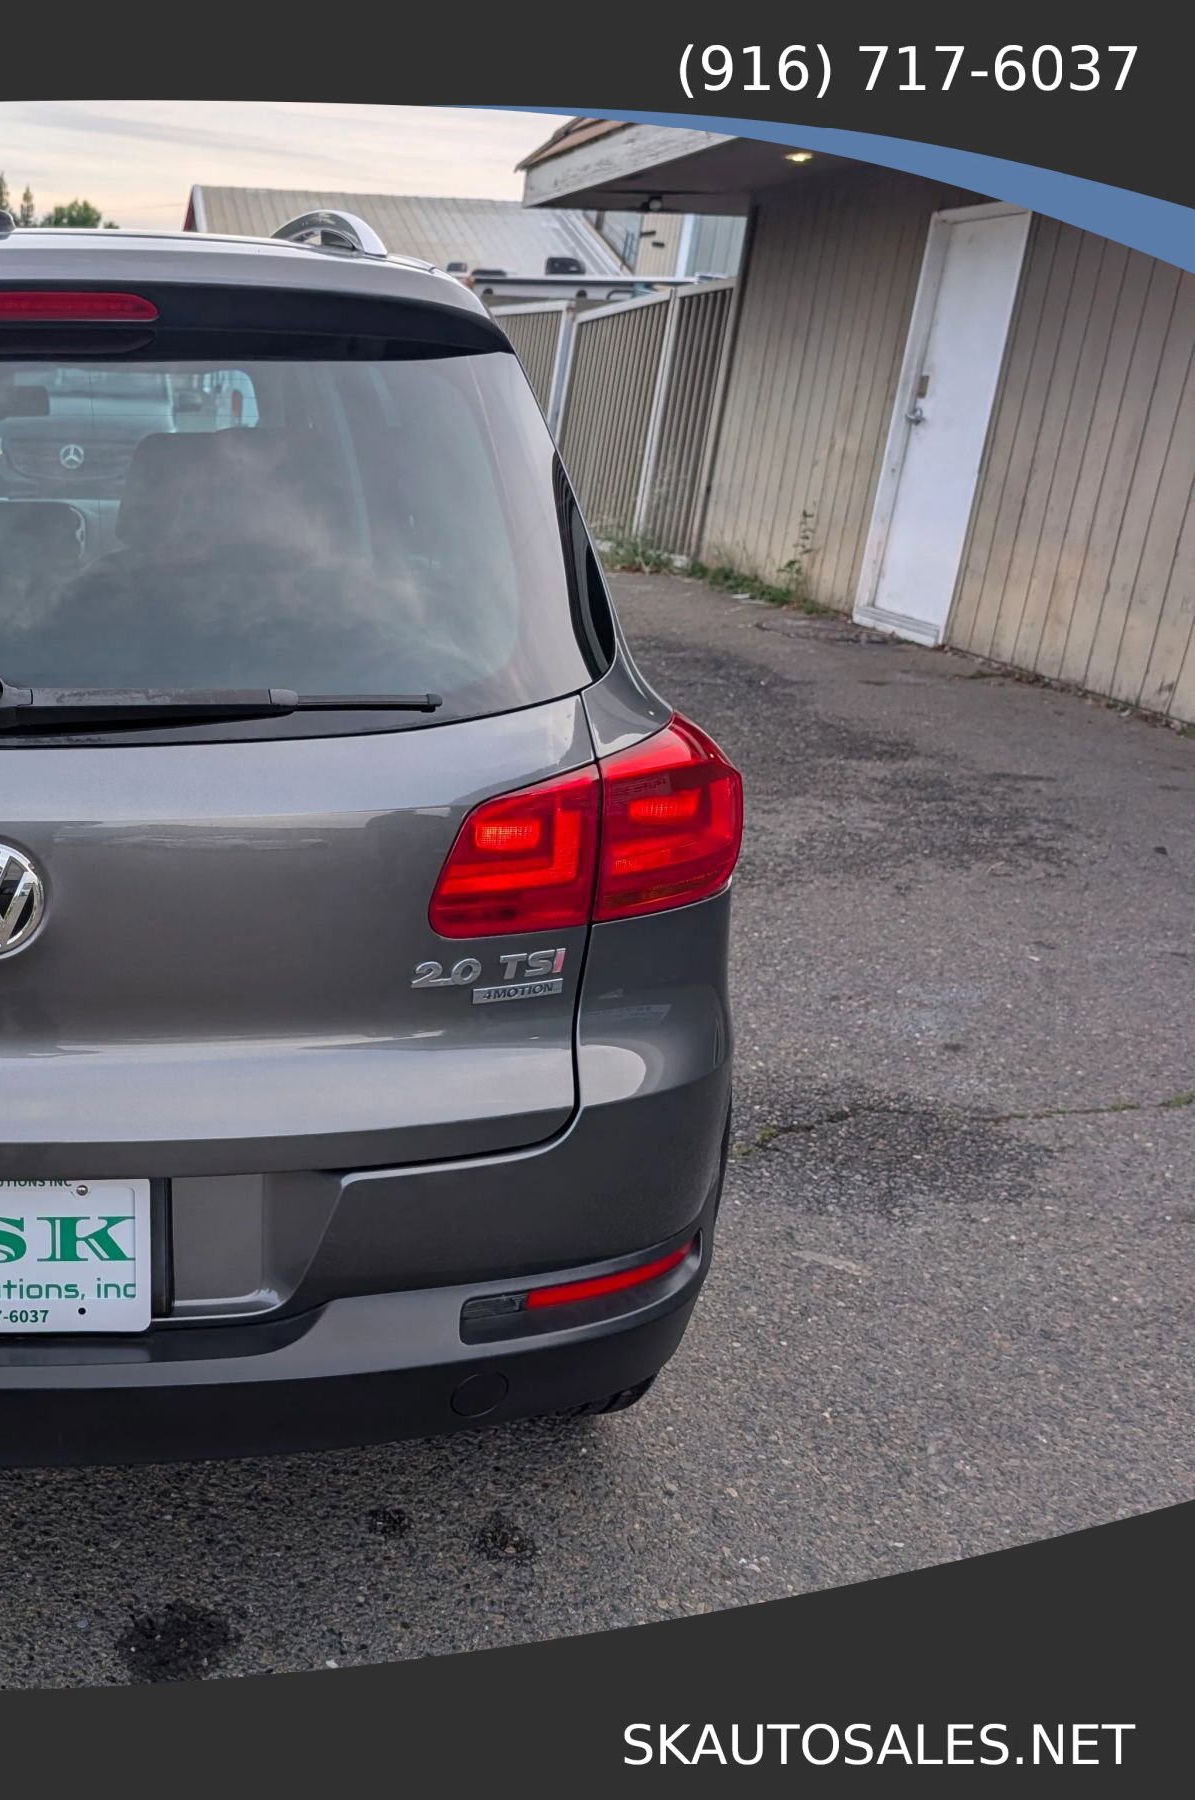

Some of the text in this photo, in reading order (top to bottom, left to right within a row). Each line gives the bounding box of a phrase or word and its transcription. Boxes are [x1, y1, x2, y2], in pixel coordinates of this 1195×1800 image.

[499, 948, 566, 980] TSI
[483, 982, 554, 1000] 4MOTION
[96, 1277, 137, 1299] inc
